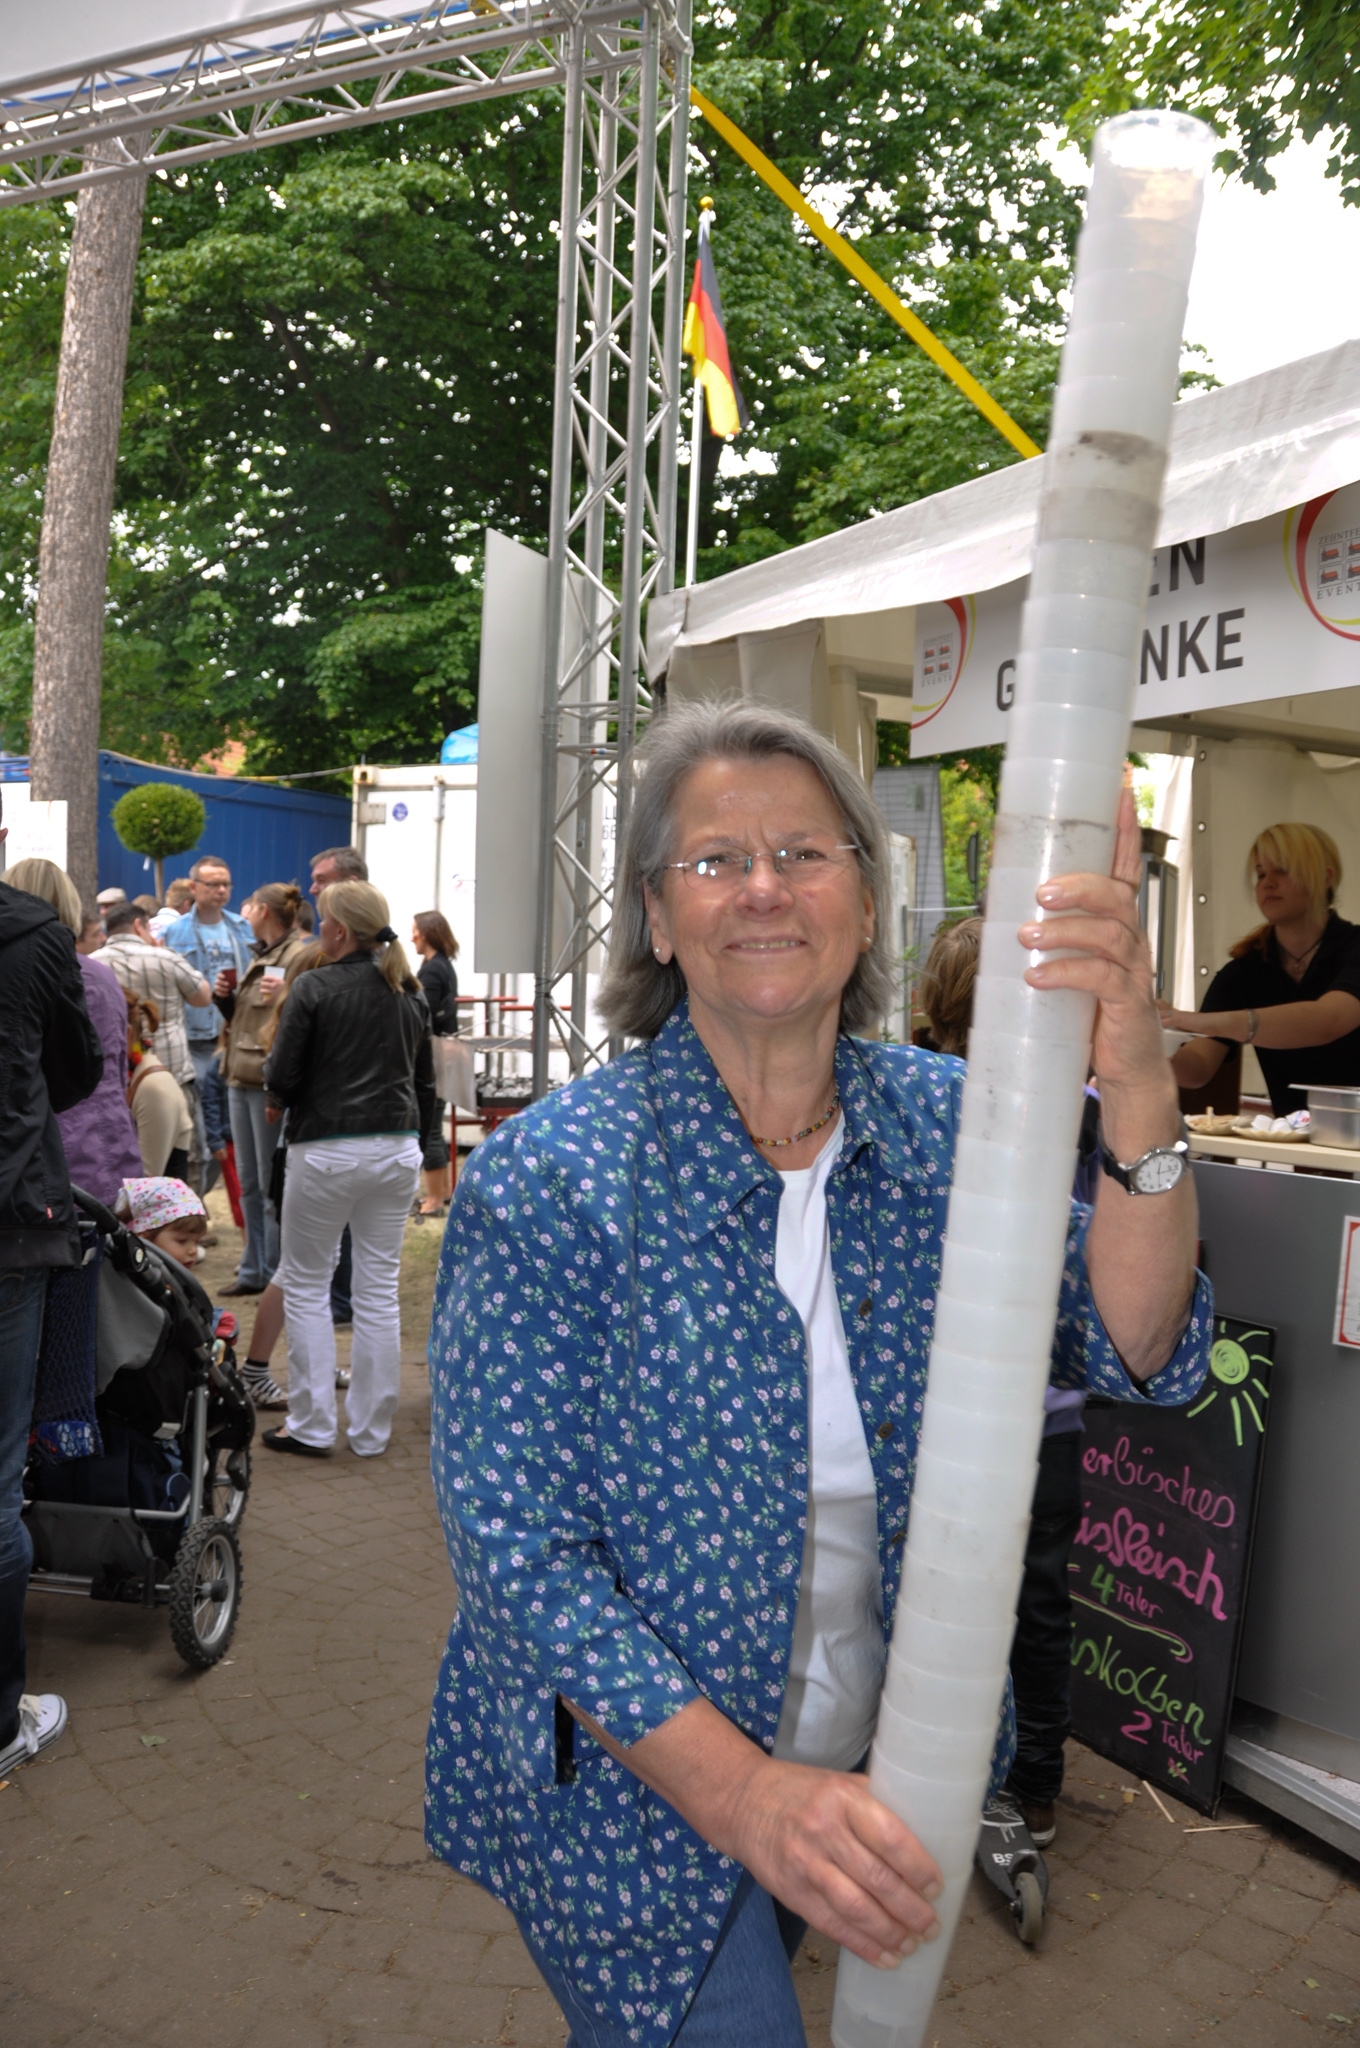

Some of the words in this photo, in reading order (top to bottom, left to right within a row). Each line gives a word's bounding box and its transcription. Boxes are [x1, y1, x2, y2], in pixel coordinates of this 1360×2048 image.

[1319, 526, 1360, 546] ZEHNTFE
[1083, 1436, 1235, 1528] erbisches
[1073, 1501, 1227, 1621] isfleisch
[1091, 1564, 1115, 1605] 4
[1115, 1580, 1163, 1618] Taler
[1120, 1710, 1152, 1745] 2
[1161, 1719, 1204, 1763] Taler
